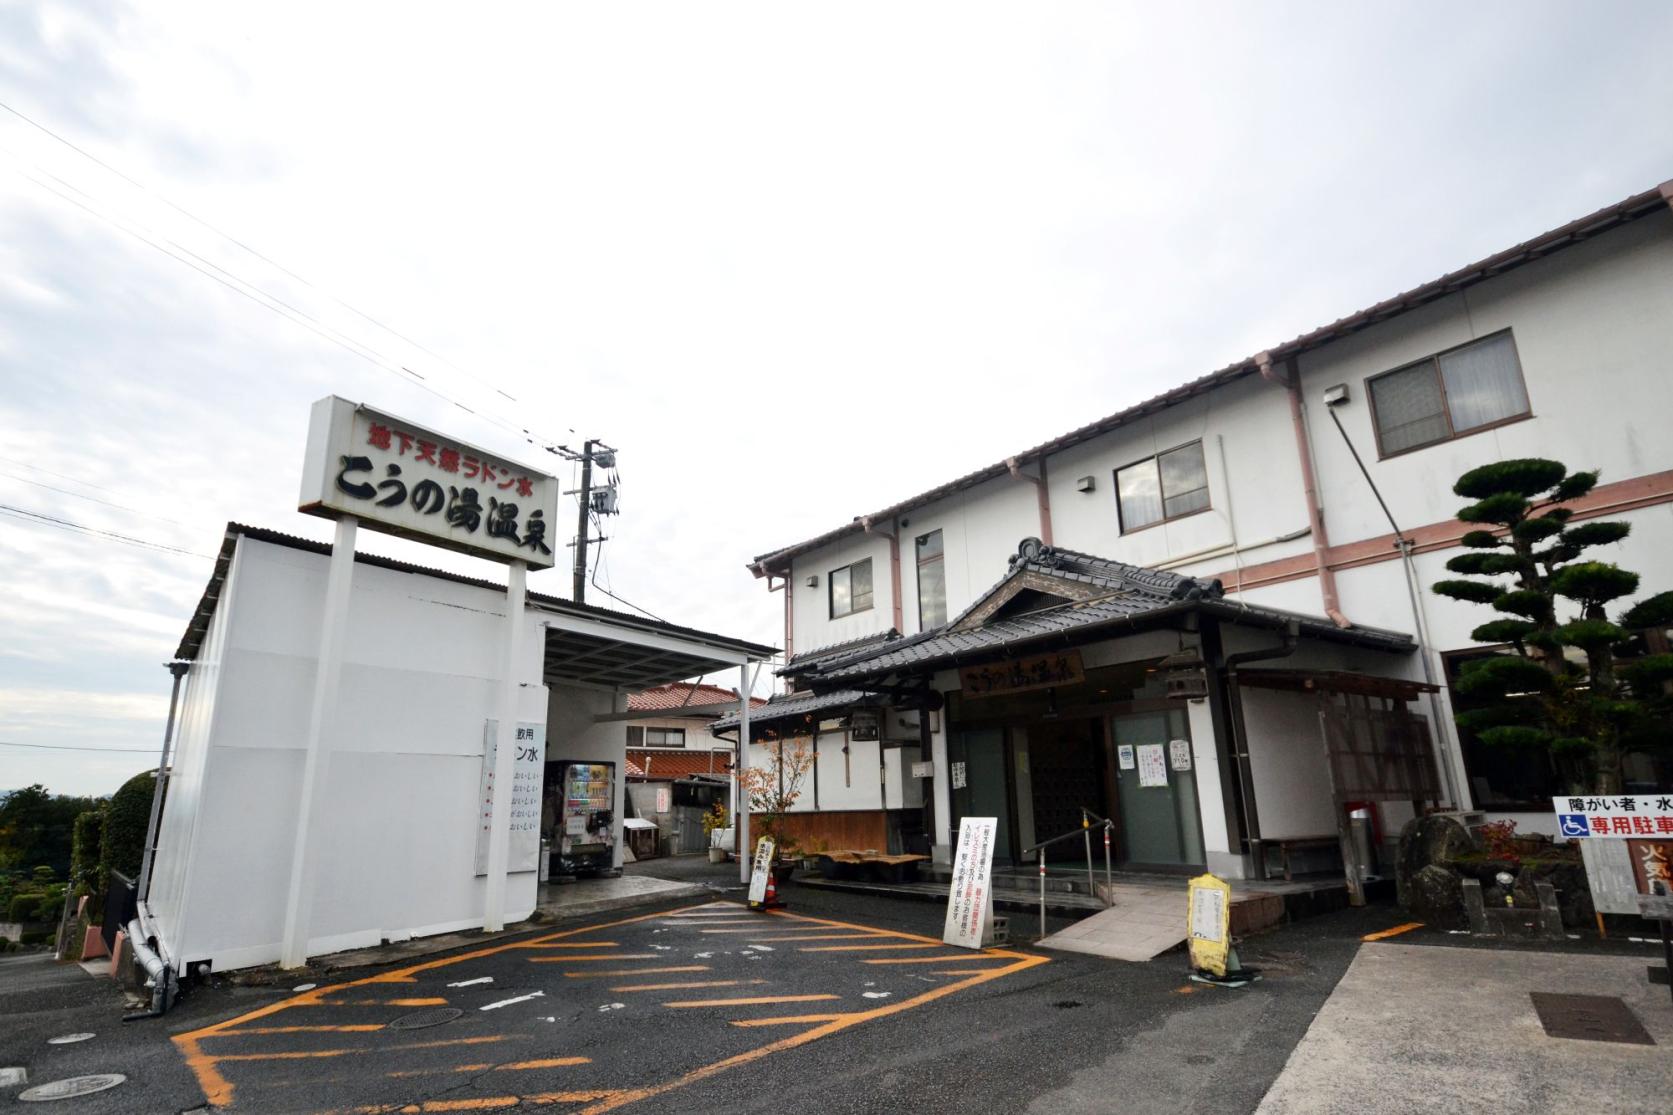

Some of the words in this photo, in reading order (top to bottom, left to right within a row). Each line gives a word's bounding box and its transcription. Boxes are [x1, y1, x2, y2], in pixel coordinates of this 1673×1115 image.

[368, 422, 533, 497] 地下天然ラドン水
[336, 455, 551, 555] こうの湯温泉
[516, 728, 533, 740] 飲用
[516, 746, 538, 762] ン水
